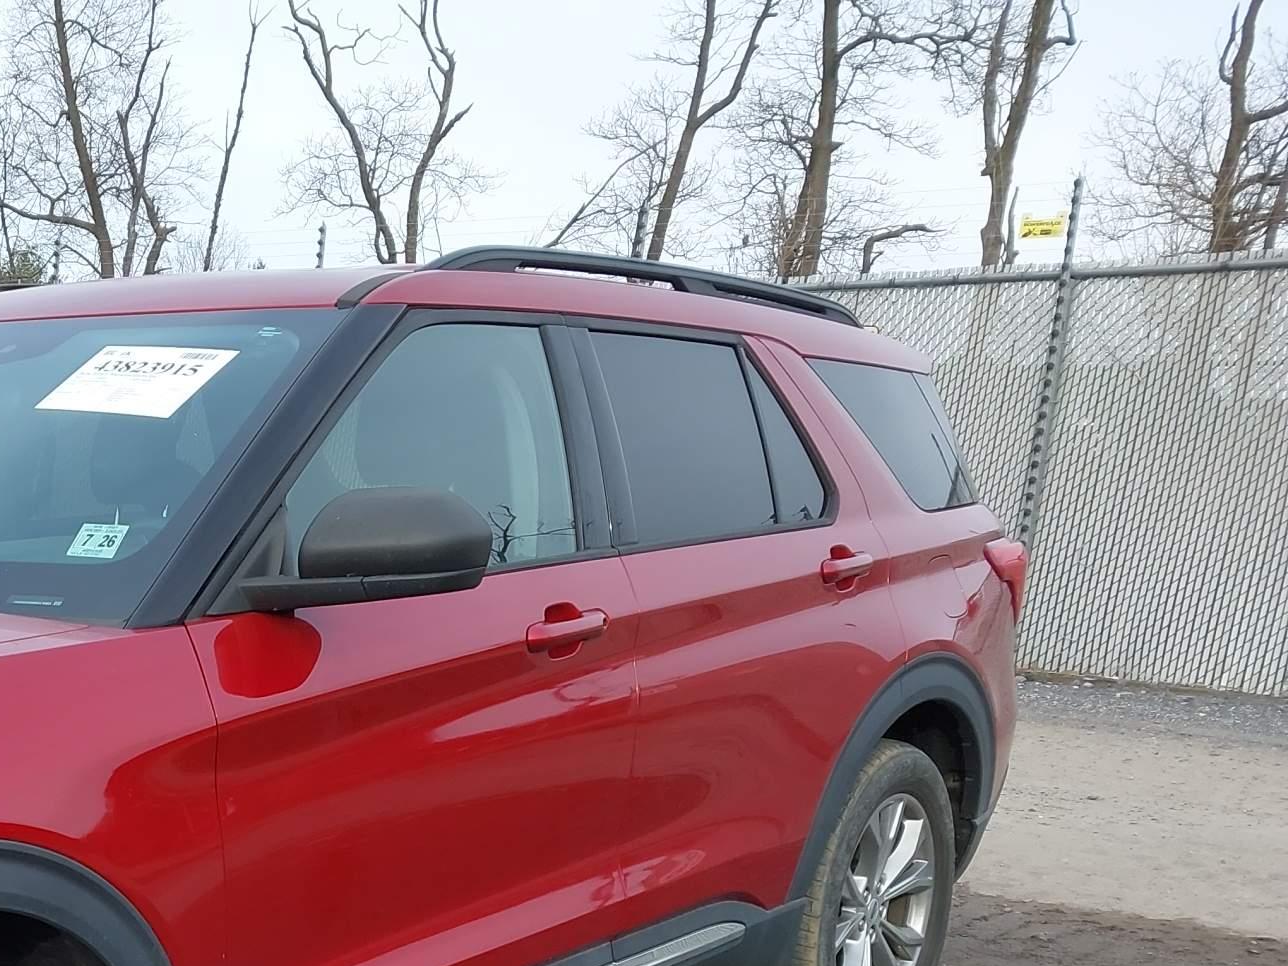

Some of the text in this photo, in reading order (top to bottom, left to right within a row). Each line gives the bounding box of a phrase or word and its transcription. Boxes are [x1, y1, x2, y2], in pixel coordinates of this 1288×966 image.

[94, 359, 205, 377] 43823915
[81, 533, 118, 548] 7 26
